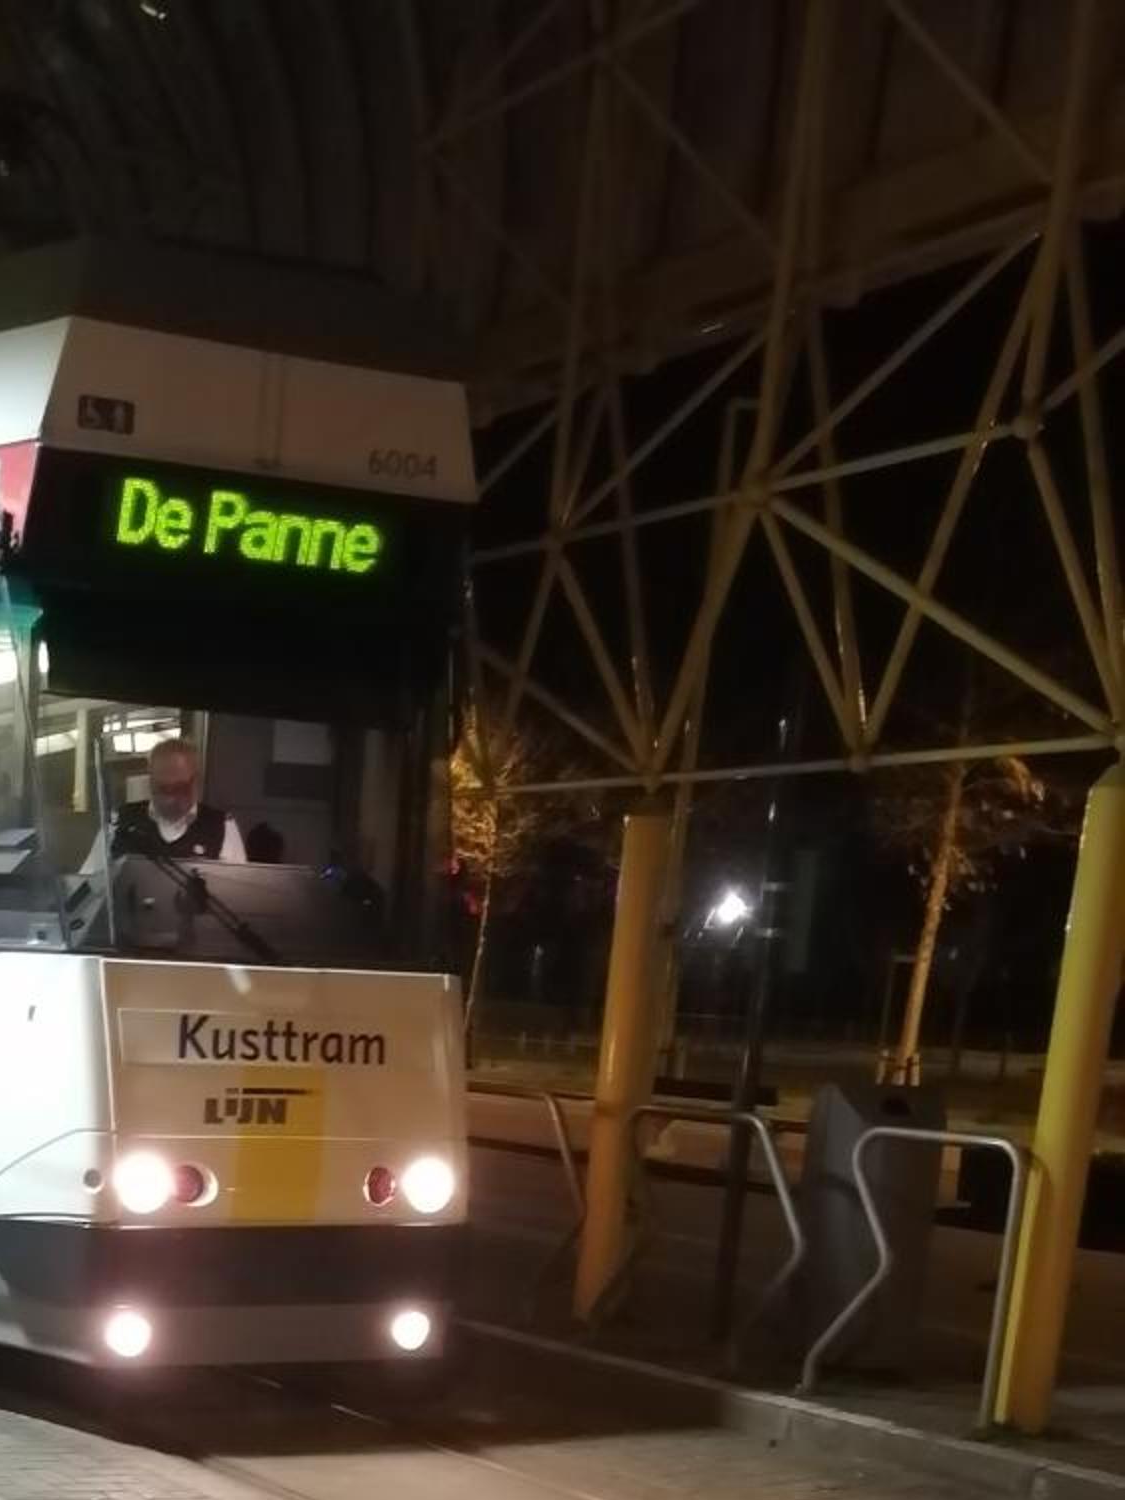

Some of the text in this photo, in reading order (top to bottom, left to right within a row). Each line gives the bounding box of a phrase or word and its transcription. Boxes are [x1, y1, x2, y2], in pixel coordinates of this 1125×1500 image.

[368, 449, 438, 481] 6004
[116, 477, 380, 572] De Panne
[178, 1014, 386, 1065] Kusttram
